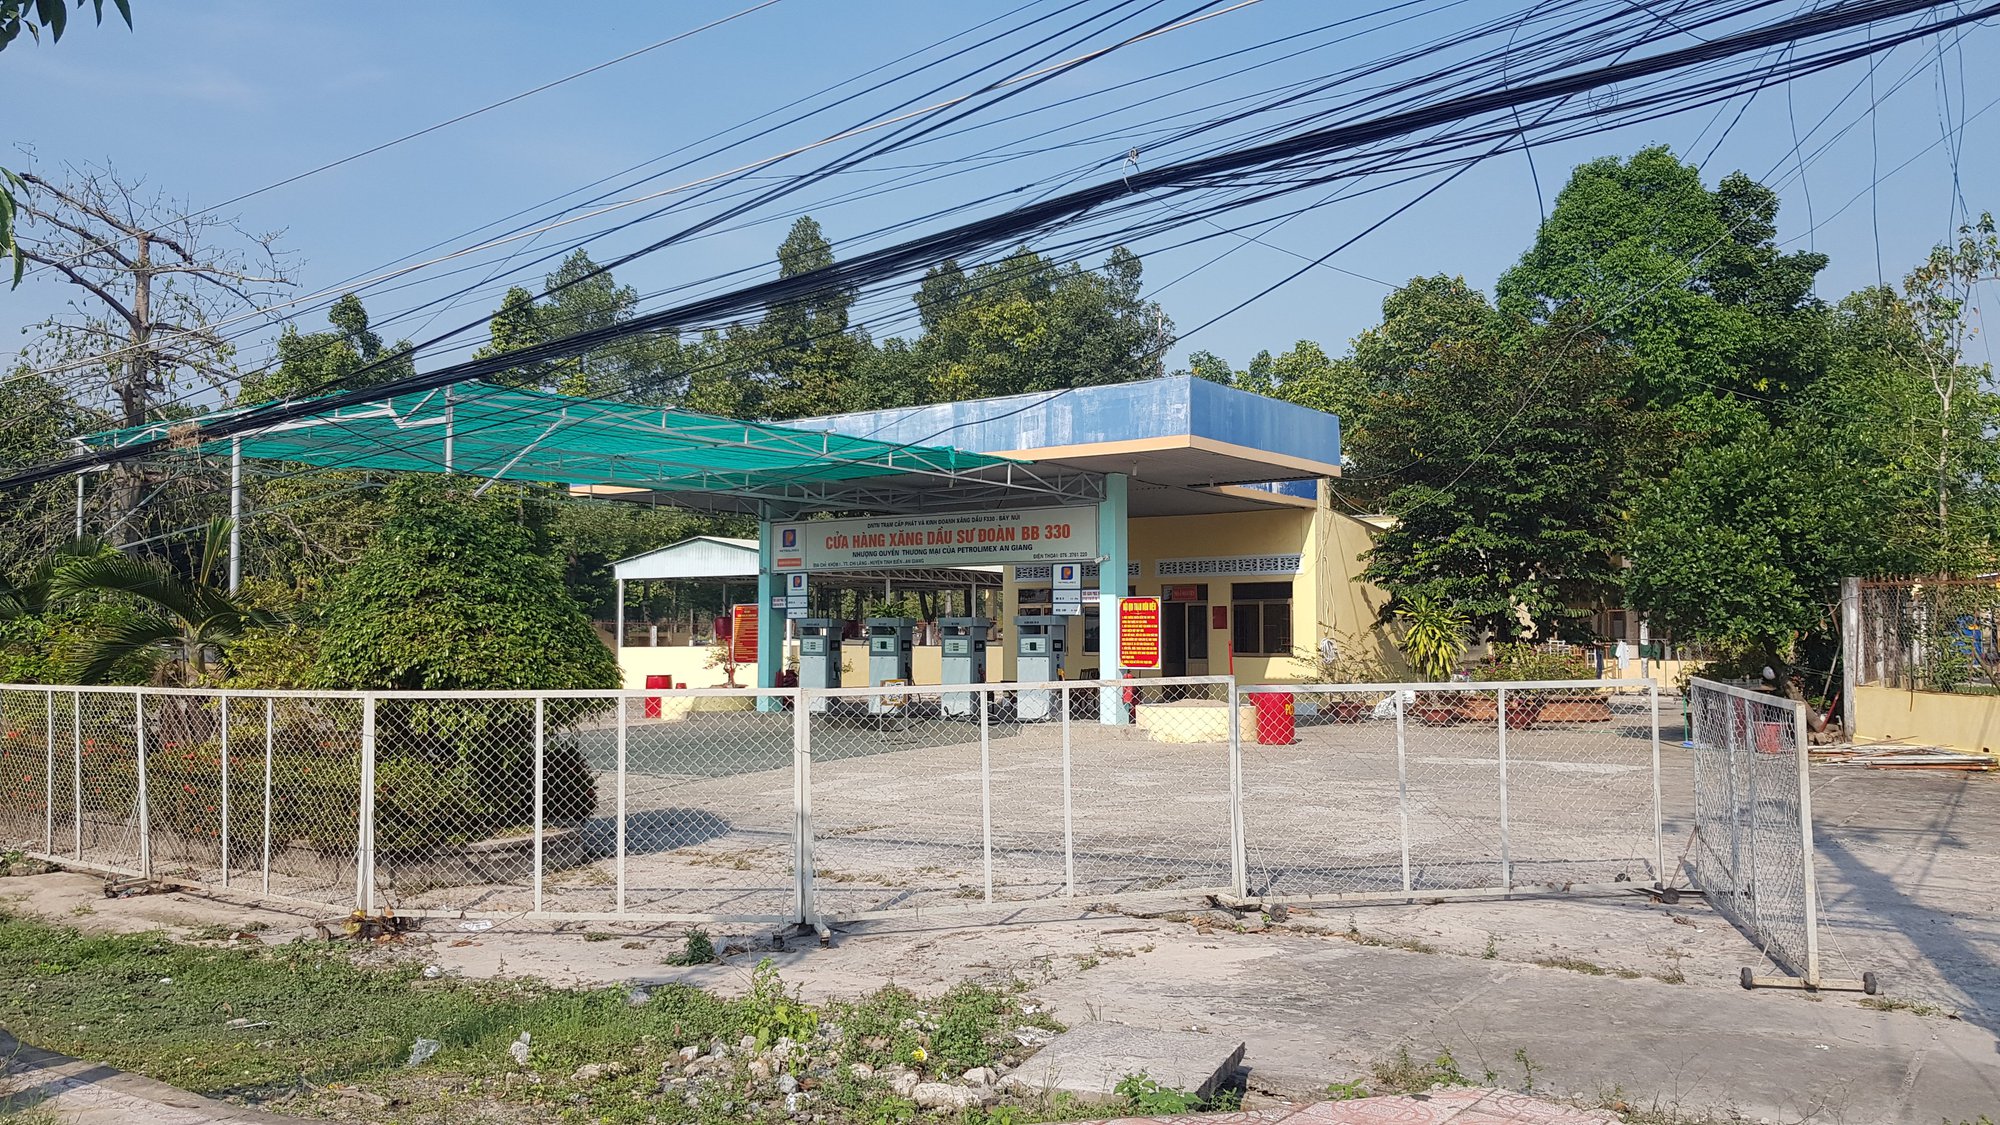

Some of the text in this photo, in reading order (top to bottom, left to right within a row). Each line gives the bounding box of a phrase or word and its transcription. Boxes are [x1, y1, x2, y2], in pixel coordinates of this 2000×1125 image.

[825, 523, 1071, 550] CỬA HÀNG XĂNG DẦU SƯ ĐOÀN BB 330
[928, 548, 941, 556] MẠI
[942, 545, 956, 554] CỦA
[957, 545, 998, 554] PETROLIMEX
[999, 544, 1010, 552] AN
[1010, 543, 1033, 552] GIANG
